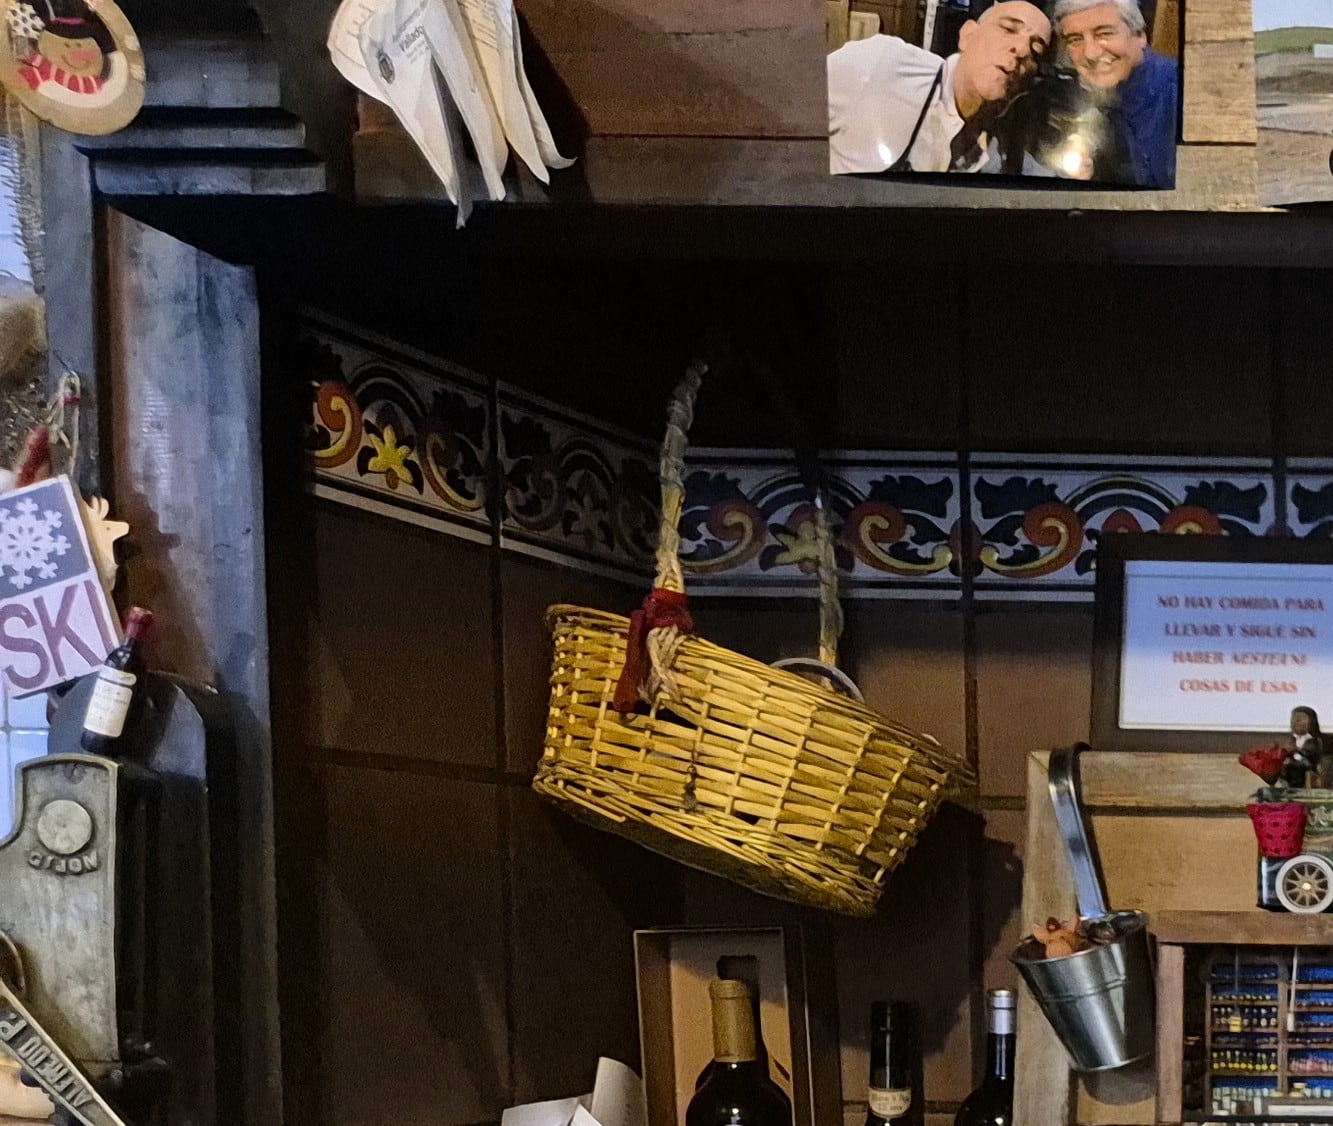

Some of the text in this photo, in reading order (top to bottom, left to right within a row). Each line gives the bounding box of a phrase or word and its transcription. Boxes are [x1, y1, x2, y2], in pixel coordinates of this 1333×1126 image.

[1158, 596, 1325, 612] NO HAY COMIDA PARA
[0, 580, 114, 690] SKI
[1165, 622, 1318, 639] LLEVAR Y SIGUE SIN
[1172, 651, 1225, 665] HABER
[1178, 679, 1299, 694] COSAS DE ESAS
